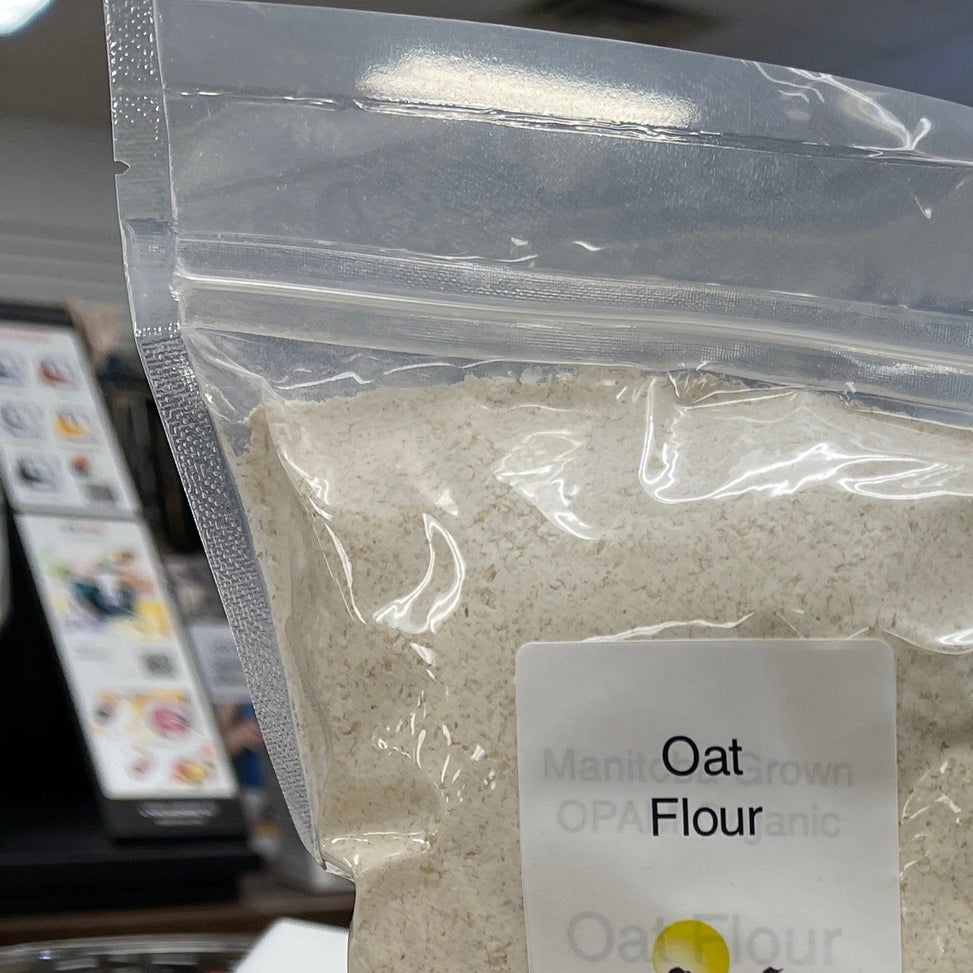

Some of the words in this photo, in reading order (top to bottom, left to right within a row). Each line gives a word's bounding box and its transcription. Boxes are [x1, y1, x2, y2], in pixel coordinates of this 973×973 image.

[661, 735, 744, 777] Oat
[735, 750, 854, 787] Grown
[651, 797, 763, 837] Flour
[567, 910, 667, 964] Oat
[693, 913, 842, 966] Flour
